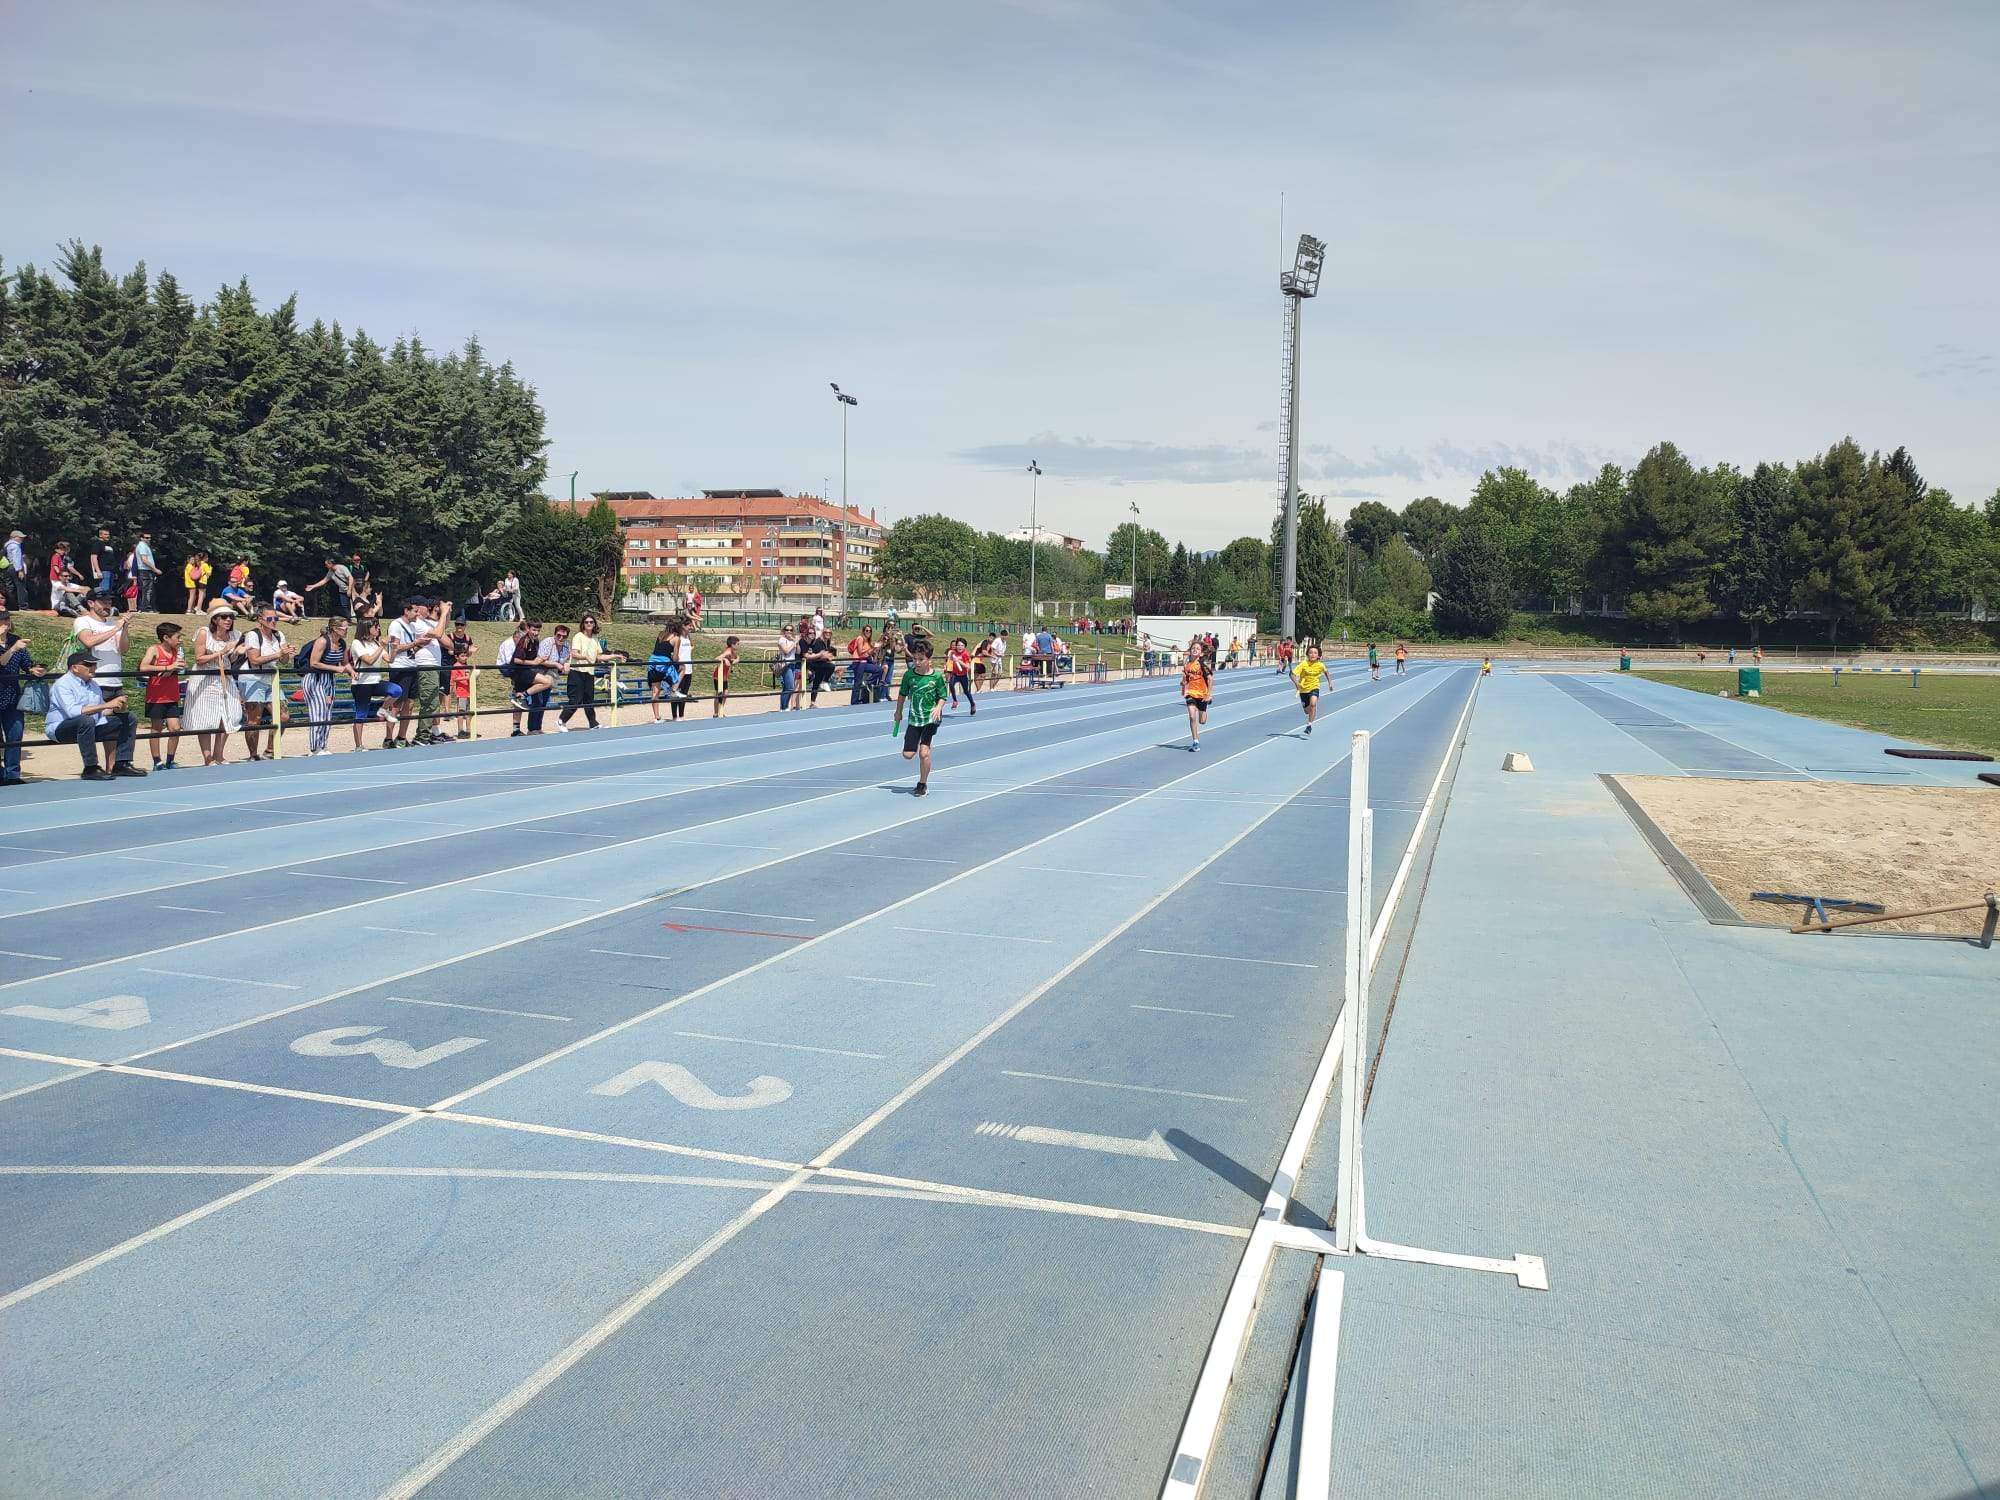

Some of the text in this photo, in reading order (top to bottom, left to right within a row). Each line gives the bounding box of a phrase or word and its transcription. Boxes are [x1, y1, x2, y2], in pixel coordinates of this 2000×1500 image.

[0, 995, 151, 1030] 4
[289, 1026, 489, 1069] 3
[591, 1060, 794, 1110] 2
